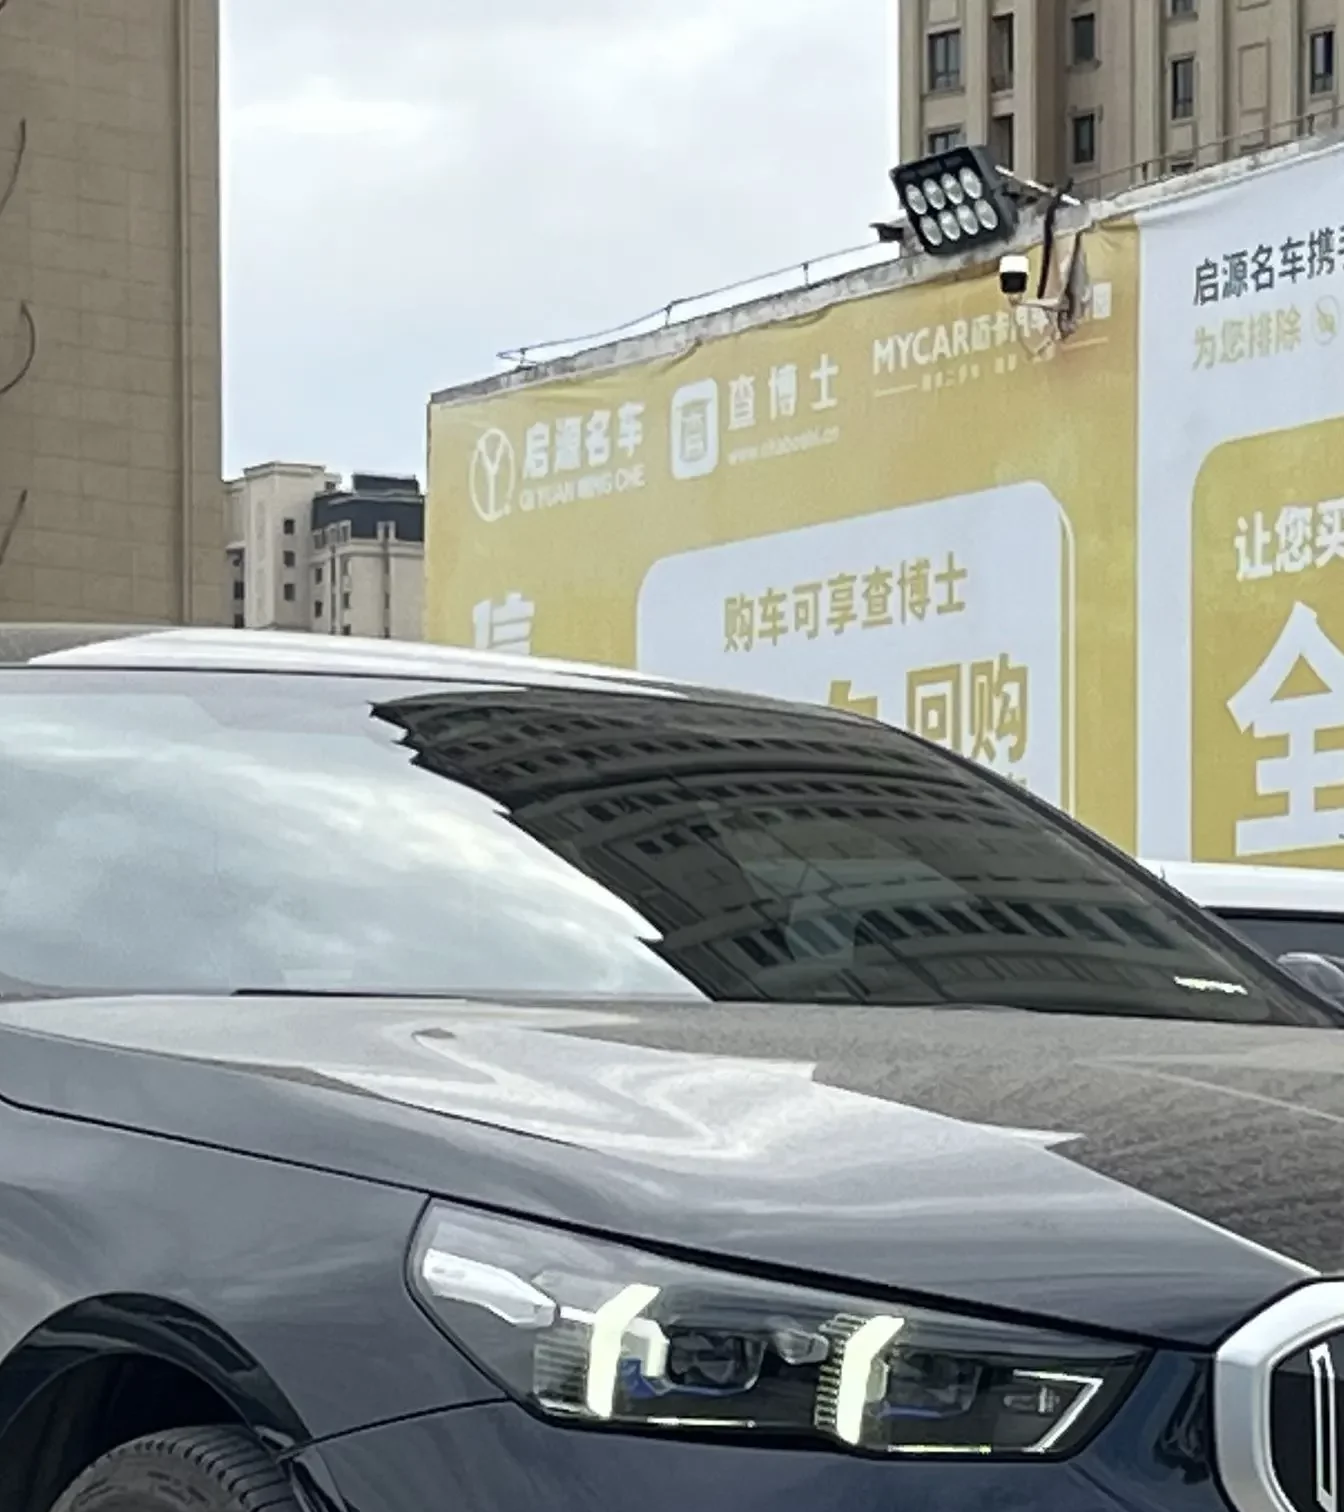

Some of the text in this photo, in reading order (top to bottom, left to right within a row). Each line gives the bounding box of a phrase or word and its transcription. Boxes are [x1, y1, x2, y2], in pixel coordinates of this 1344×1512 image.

[873, 319, 970, 376] MYCAR
[1192, 303, 1302, 369] 为您排除
[728, 353, 840, 431] 查博士
[523, 402, 646, 479] 启源名车
[723, 551, 968, 652] 购车可享查博士
